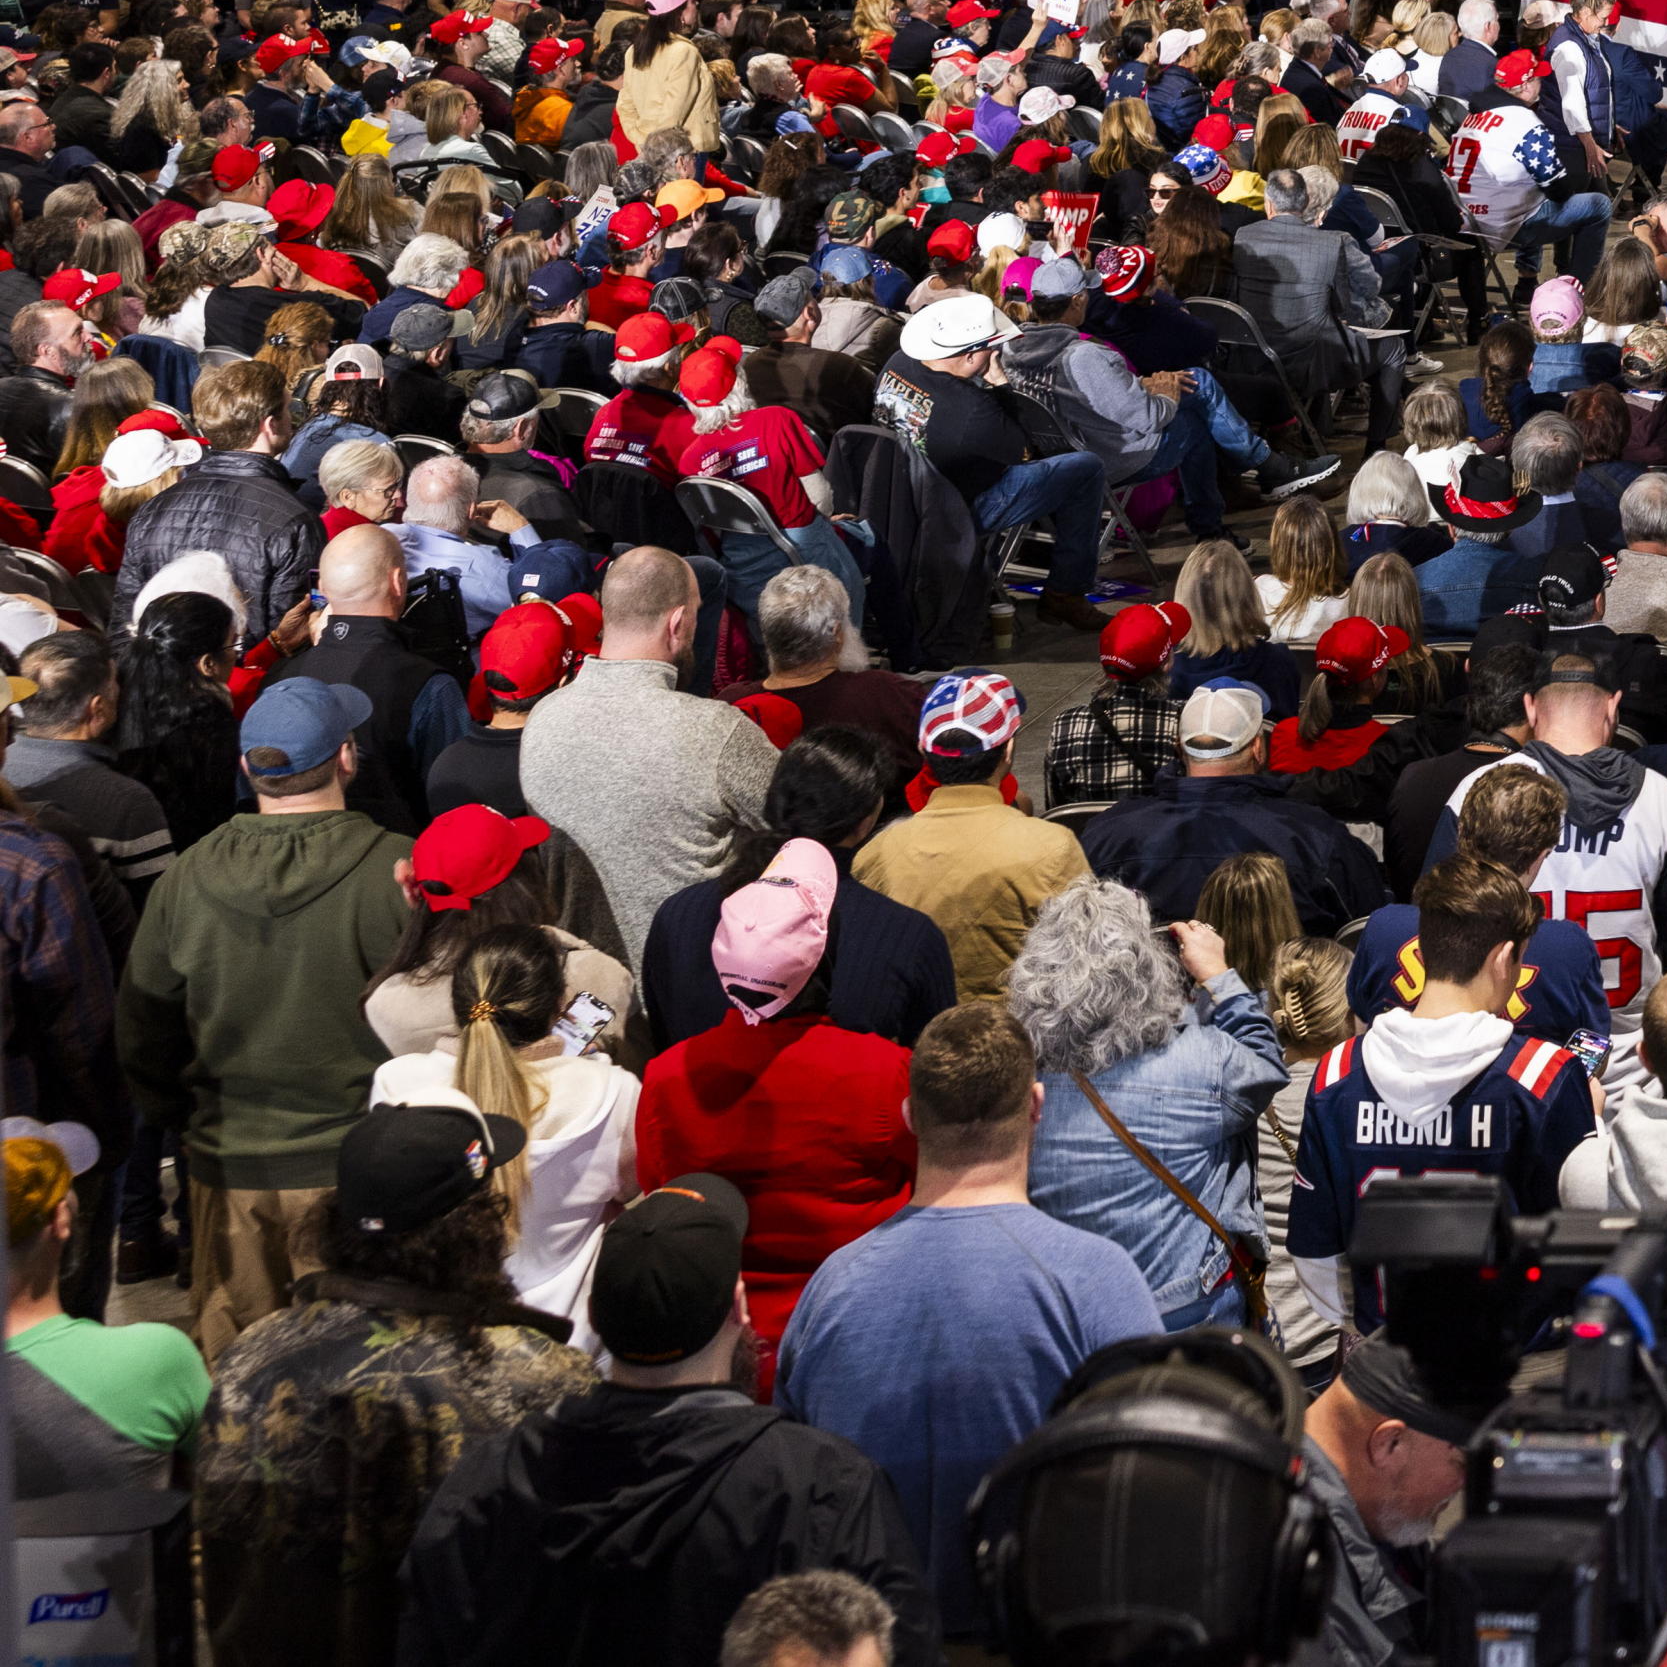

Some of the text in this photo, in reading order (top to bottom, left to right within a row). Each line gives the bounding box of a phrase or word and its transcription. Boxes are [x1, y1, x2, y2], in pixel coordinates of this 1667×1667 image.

[1339, 111, 1387, 131] TRUMP
[881, 372, 935, 415] NAPLES
[736, 445, 757, 462] SAVE
[732, 456, 767, 477] AMERICA!
[1557, 577, 1574, 594] TRUMP
[1356, 1100, 1492, 1148] BRUNO H
[35, 1594, 108, 1623] Purell
